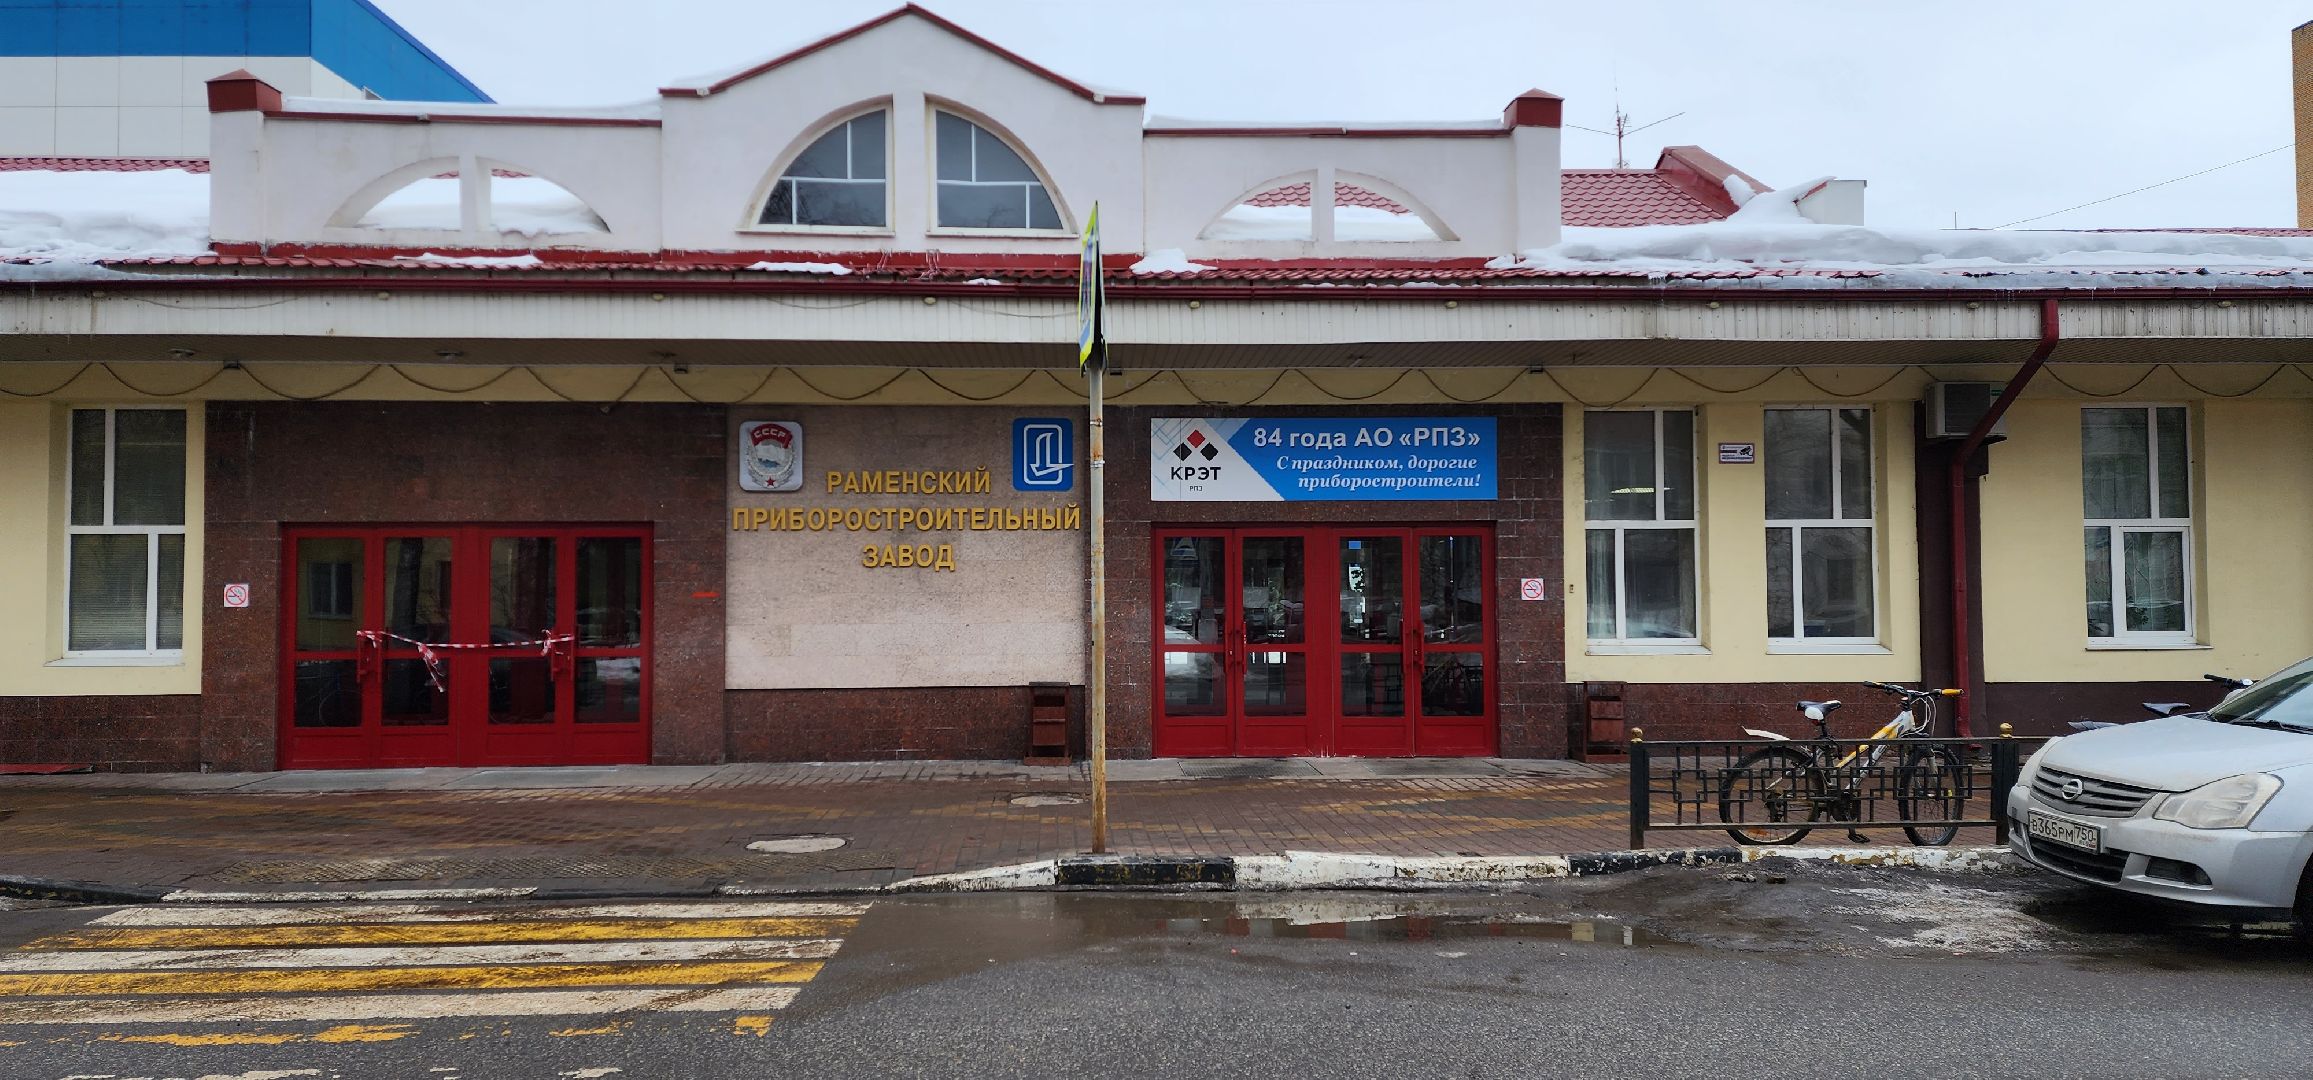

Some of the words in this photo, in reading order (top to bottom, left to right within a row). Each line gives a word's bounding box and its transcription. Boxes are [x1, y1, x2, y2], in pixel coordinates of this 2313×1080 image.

[753, 428, 786, 438] СССР
[1253, 427, 1282, 447] 84
[1289, 432, 1347, 450] года
[1354, 427, 1393, 447] АО
[1399, 426, 1481, 447] «РПЗ»
[1170, 466, 1222, 481] КРЭТ
[1276, 455, 1289, 470] С
[1291, 455, 1404, 473] праздником,
[1407, 454, 1478, 473] дорогие
[826, 466, 991, 494] РАМЕНСКИЙ
[1298, 473, 1481, 492] приборостроители!
[732, 503, 1081, 531] ПРИБОРОСТРОИТЕЛЬНЫЙ
[862, 544, 955, 572] ЗАВОД
